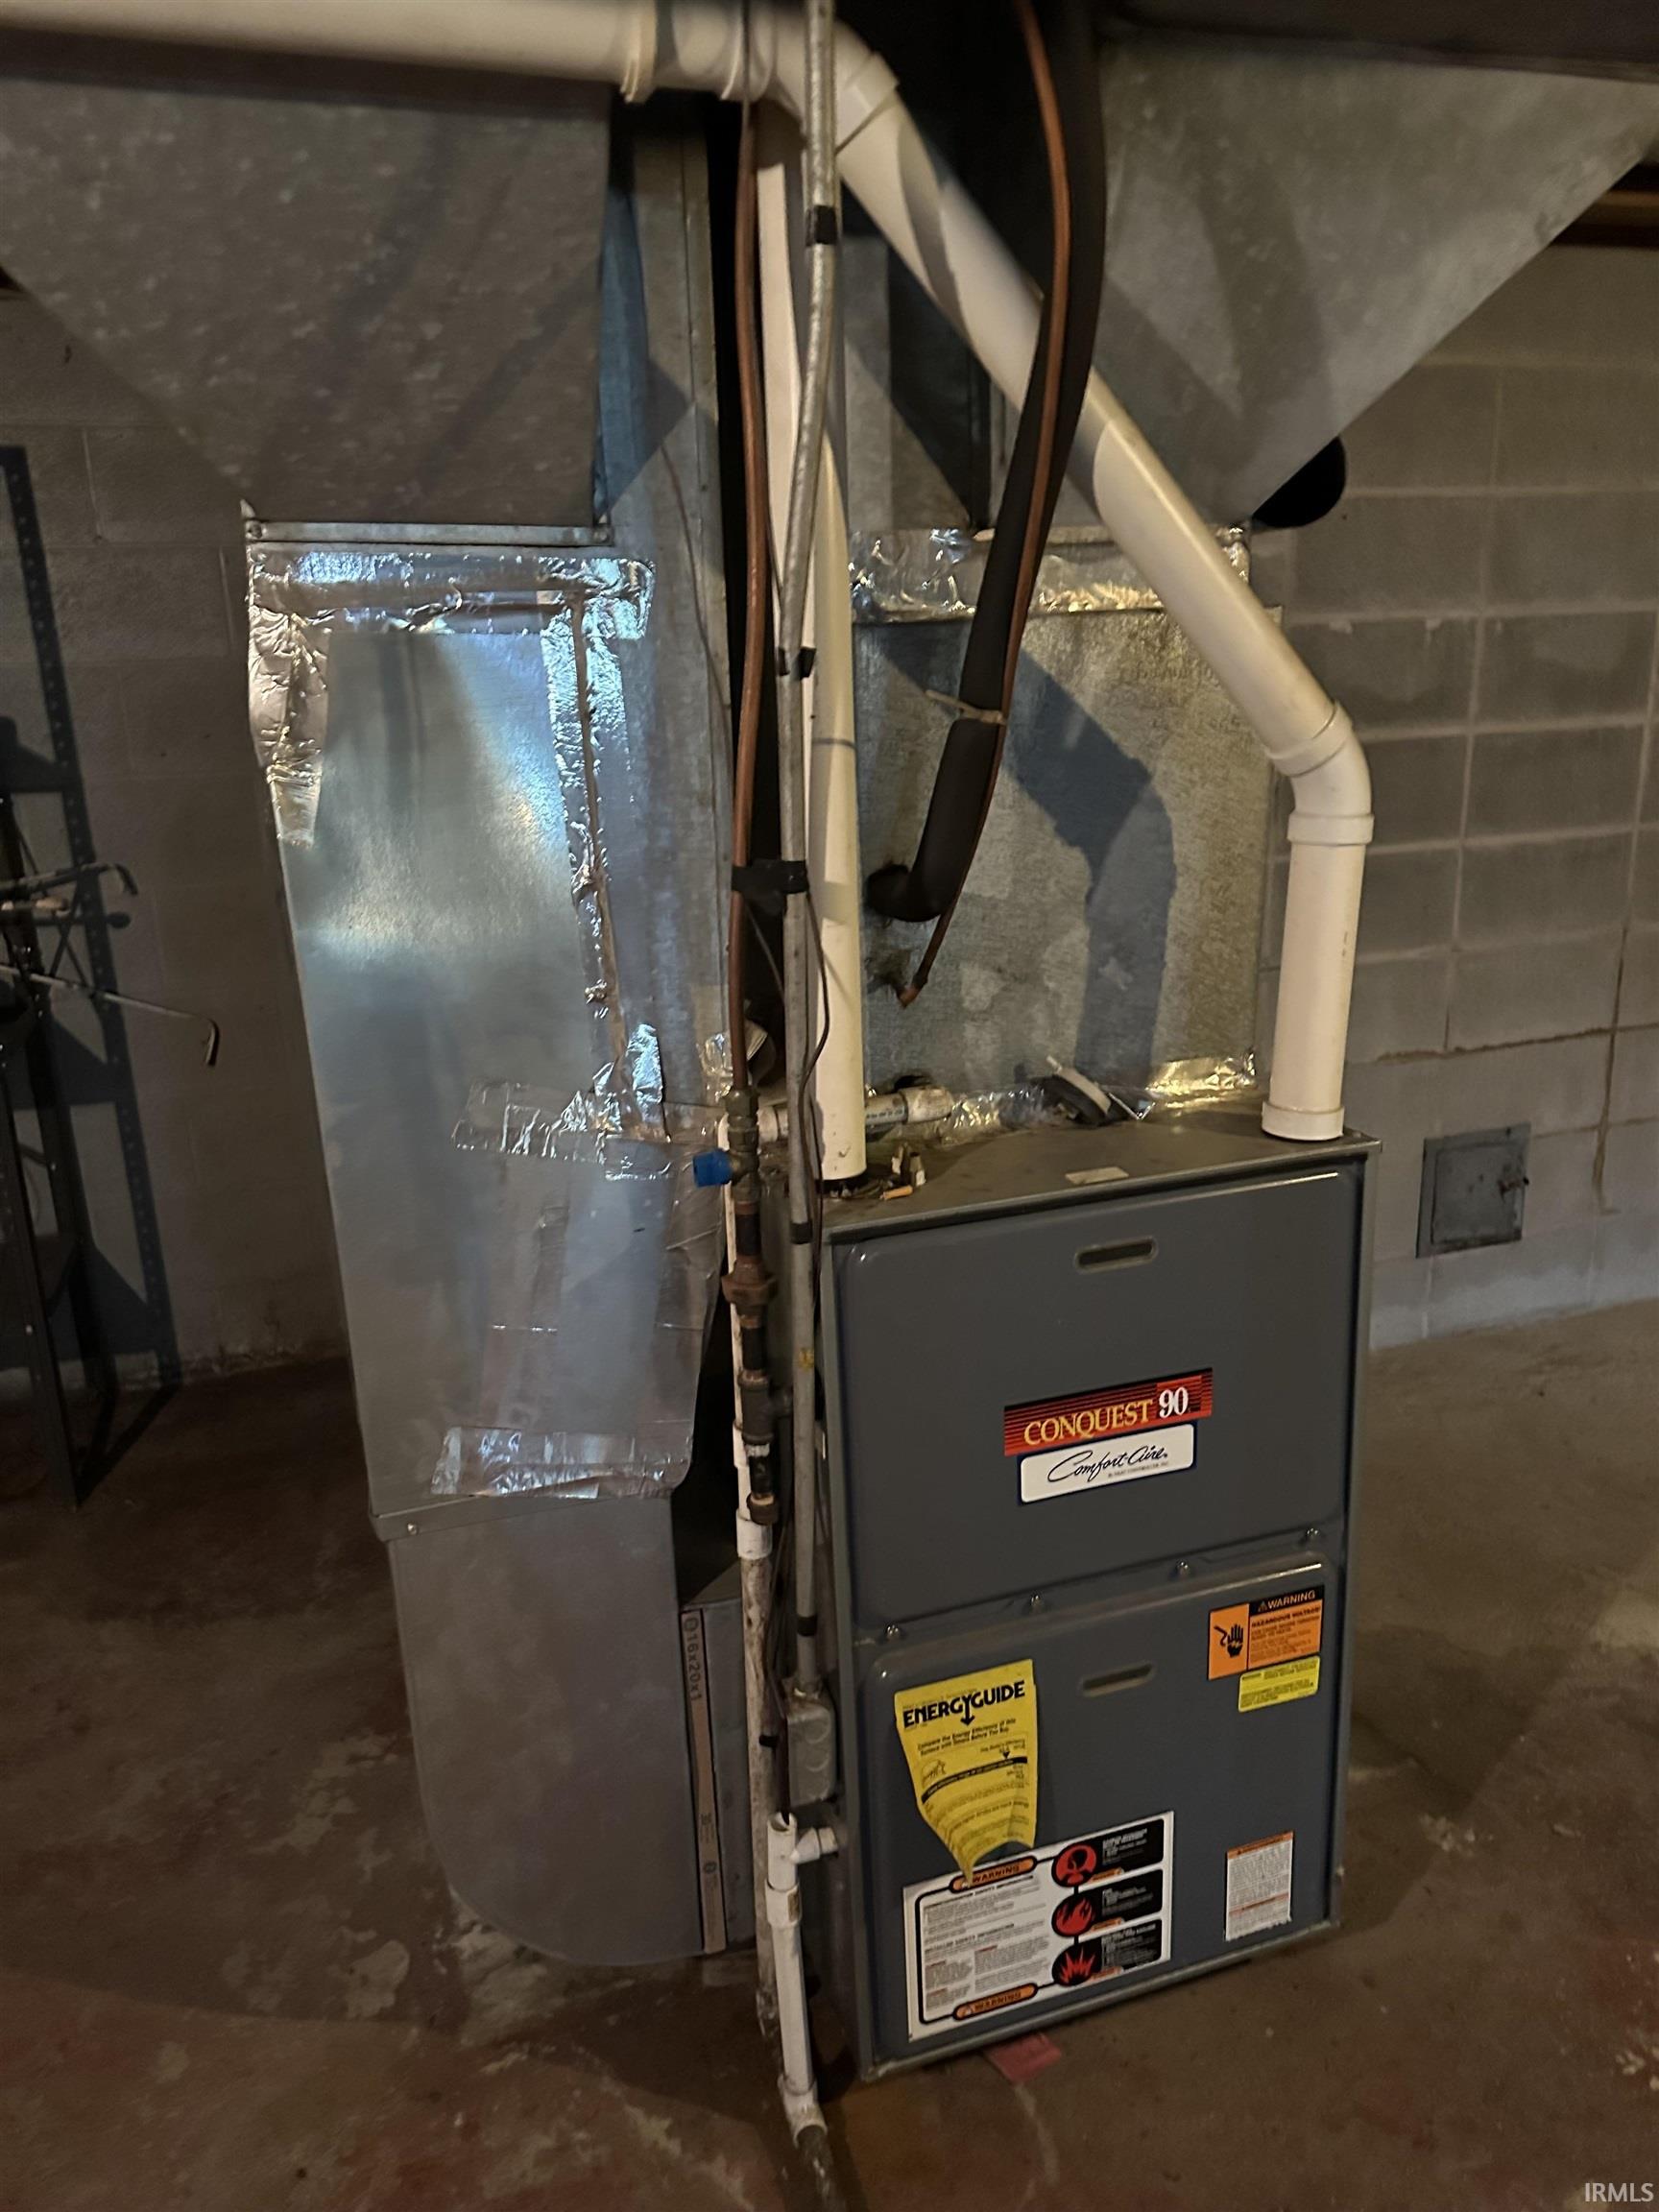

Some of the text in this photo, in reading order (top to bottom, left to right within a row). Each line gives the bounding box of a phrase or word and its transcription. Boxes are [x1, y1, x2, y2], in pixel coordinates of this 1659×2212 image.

[1023, 1386, 1190, 1446] CONQUEST 90
[1266, 1590, 1316, 1610] WARNING
[973, 1864, 1021, 1884] WARNING
[974, 1991, 1022, 2010] WARNING
